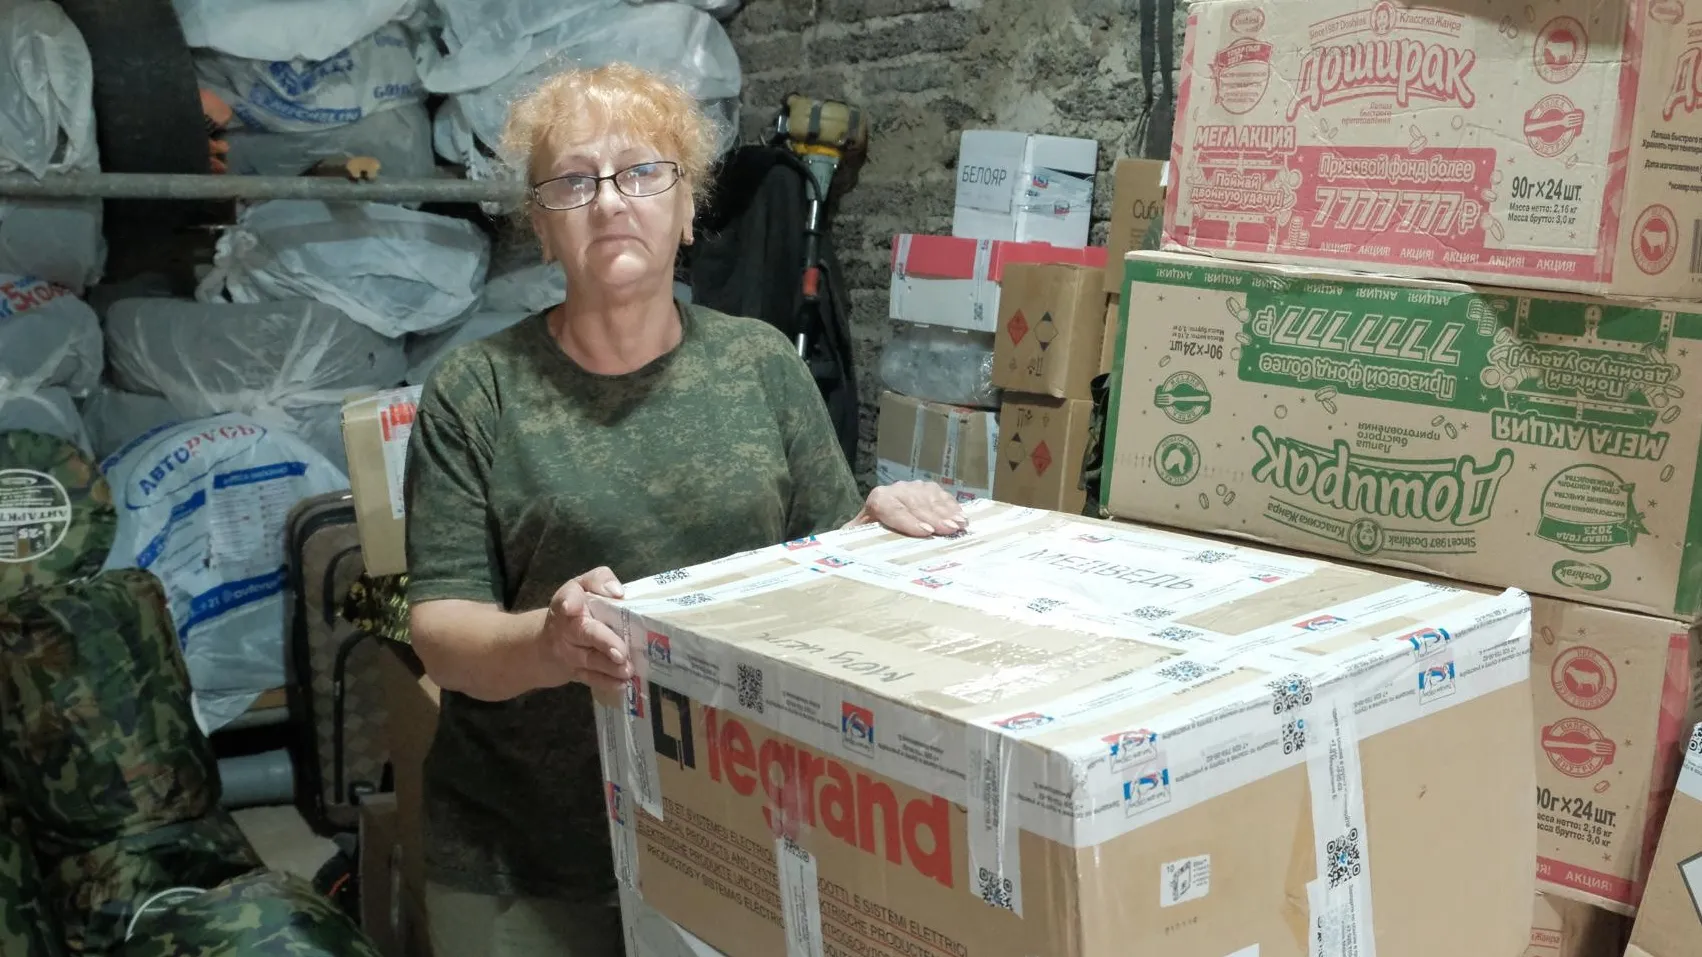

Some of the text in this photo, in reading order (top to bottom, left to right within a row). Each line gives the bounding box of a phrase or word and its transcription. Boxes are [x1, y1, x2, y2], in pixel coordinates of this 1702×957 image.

[1400, 12, 1462, 32] Классика Жанра
[1286, 38, 1476, 122] Доширак
[1192, 125, 1297, 154] МЕГА АКЦИЯ
[961, 164, 1007, 187] БЕЛОЯР
[1319, 153, 1475, 185] Призовой фонд более
[1214, 170, 1262, 191] Поймай
[1191, 185, 1286, 209] двойную удачу!
[1509, 202, 1530, 212] Масса
[1530, 205, 1553, 214] нетто:
[1553, 204, 1570, 214] 2,16
[1507, 212, 1576, 226] Масса брутто: 3,0 кг
[1320, 241, 1577, 272] АКЦИЯ! АКЦИЯ! АКЦИЯ! АКЦИЯ! АКЦИЯ! АКЦИЯ!
[1155, 267, 1194, 281] АКЦИЯ!
[1204, 272, 1243, 286] АКЦИЯ!
[1303, 283, 1345, 297] АКЦИЯ!
[1356, 287, 1398, 302] АКЦИЯ!
[1408, 291, 1452, 307] АКЦИЯ!
[1507, 344, 1671, 385] двойную удачу!
[1259, 353, 1457, 401] Призовой фонд более
[1545, 367, 1626, 400] Поймай
[1356, 431, 1409, 447] быстрого
[1357, 422, 1441, 442] приготовления
[1491, 410, 1671, 461] МЕГА АКЦИЯ
[1355, 439, 1393, 455] Лапша
[1252, 425, 1514, 527] Доширак
[1267, 501, 1346, 538] Классика Жанра
[1584, 525, 1613, 535] 2023
[1388, 535, 1477, 548] Since 1987 Doshirak
[1555, 531, 1580, 543] ГОДА
[1018, 548, 1195, 591] МЕДВЕДЬ
[1559, 567, 1602, 584] Doshirak
[703, 703, 954, 889] legrand
[1556, 818, 1582, 831] нетто:
[1582, 823, 1602, 836] 2,16
[1602, 828, 1613, 838] кг
[1594, 807, 1617, 828] шт.
[1554, 825, 1585, 841] брутто:
[1586, 833, 1602, 846] 3,0
[1601, 838, 1612, 848] кг
[1565, 870, 1613, 892] АКЦИЯ!
[853, 893, 862, 909] E
[862, 899, 907, 930] SISTEMI
[908, 919, 968, 957] ELETTRICI
[1534, 931, 1561, 944] Жанра
